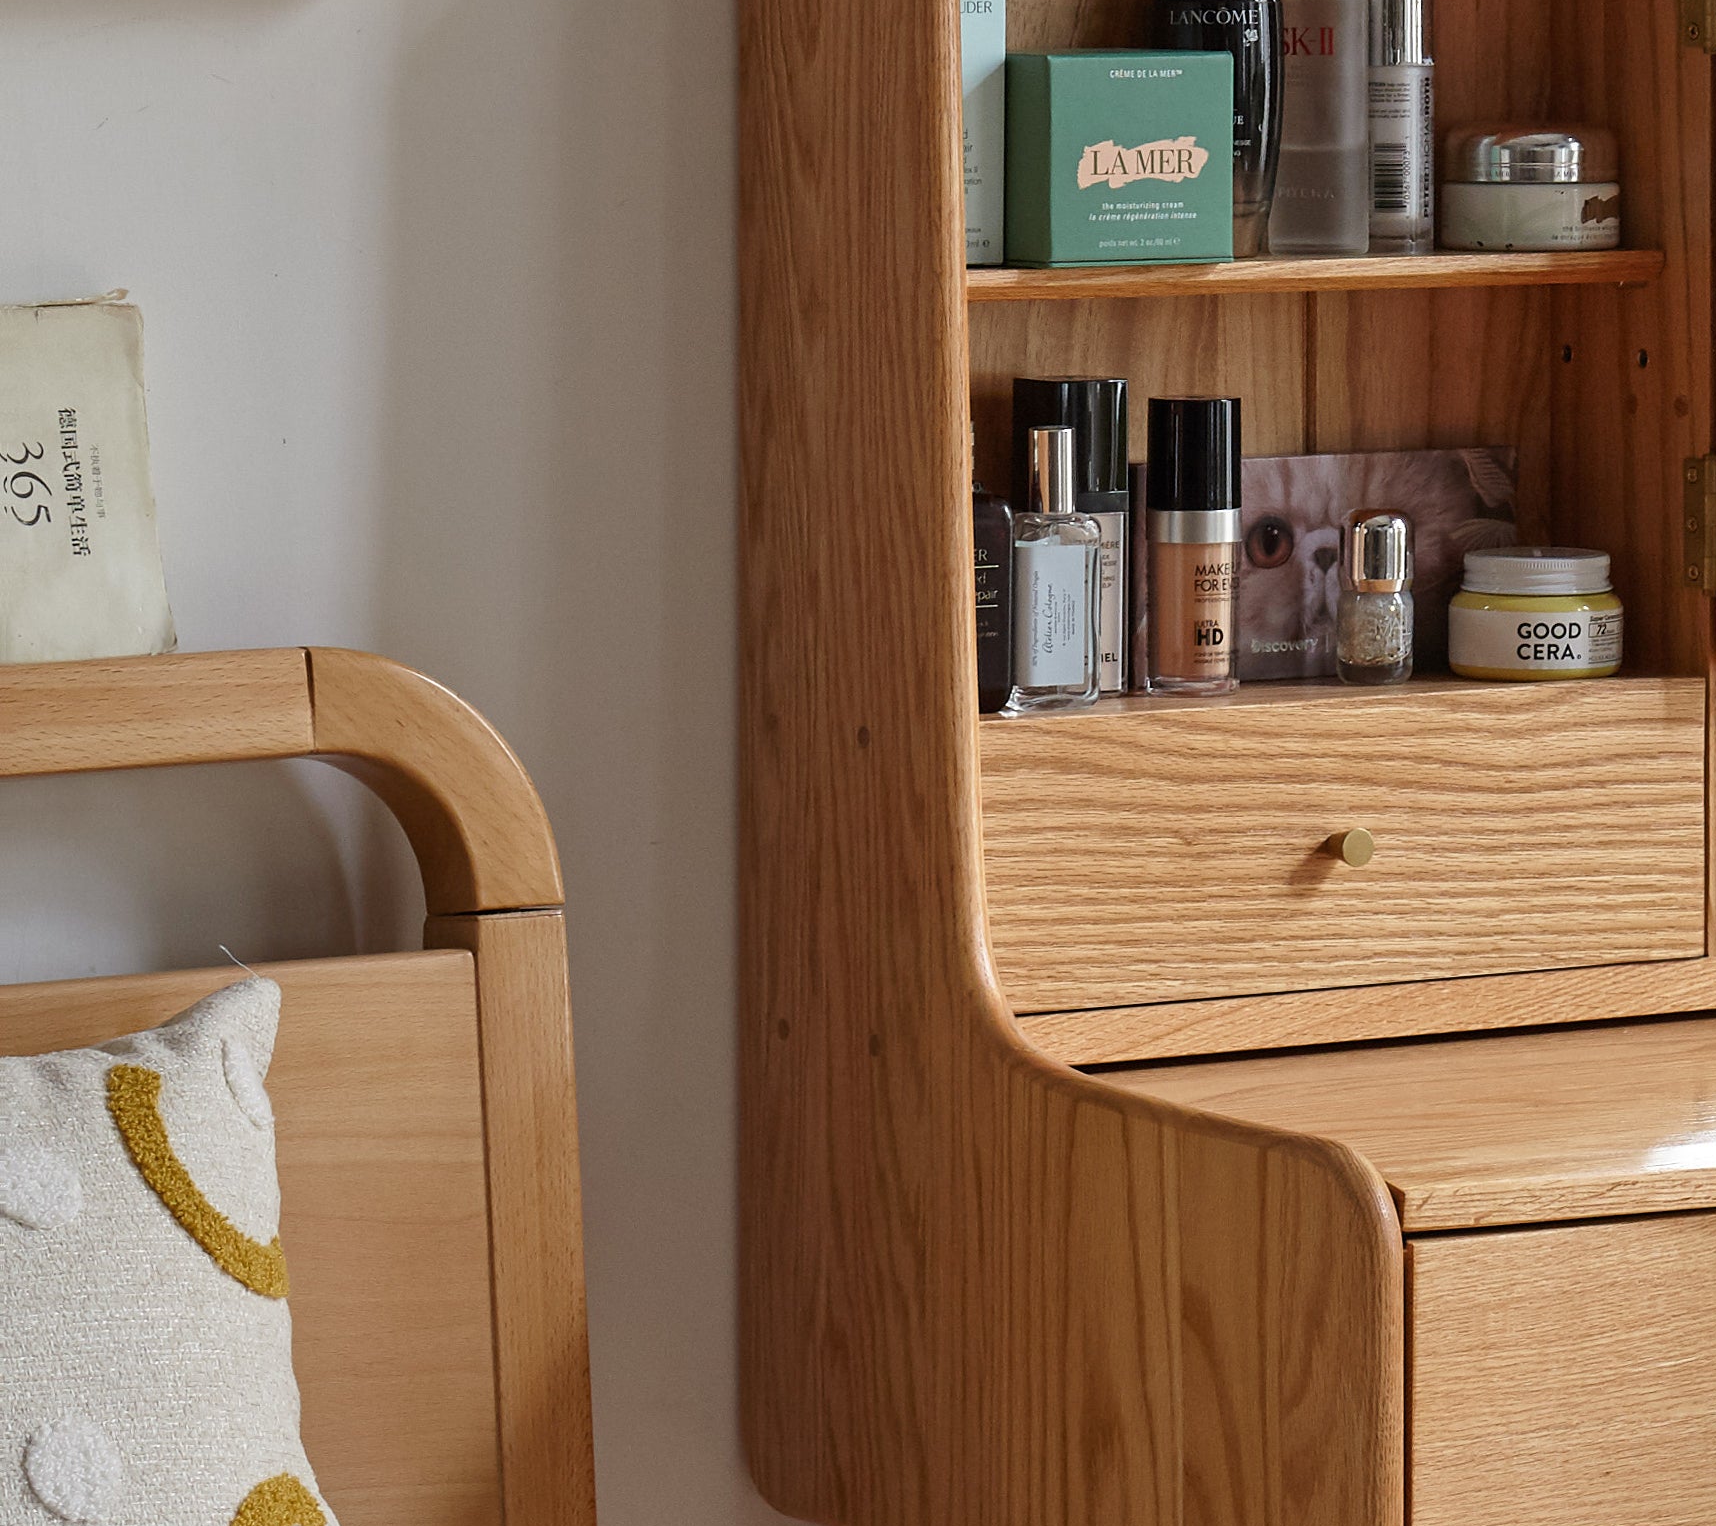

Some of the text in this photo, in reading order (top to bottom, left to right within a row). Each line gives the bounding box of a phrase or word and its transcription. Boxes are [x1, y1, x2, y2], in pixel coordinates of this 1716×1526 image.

[1169, 6, 1260, 25] LANCÔME
[1136, 69, 1147, 79] DE
[1148, 69, 1159, 78] LA
[1090, 148, 1196, 176] LA MER
[1102, 201, 1184, 211] the moisturizing cream
[6, 441, 53, 526] 365
[57, 406, 92, 557] 德国式简单生活
[1194, 562, 1230, 577] MAKE
[1194, 578, 1219, 592] FOR
[1041, 620, 1053, 654] Atelier
[1196, 627, 1224, 646] HD
[1517, 622, 1582, 640] GOOD
[1596, 623, 1608, 635] 72
[1250, 637, 1319, 654] Discovery
